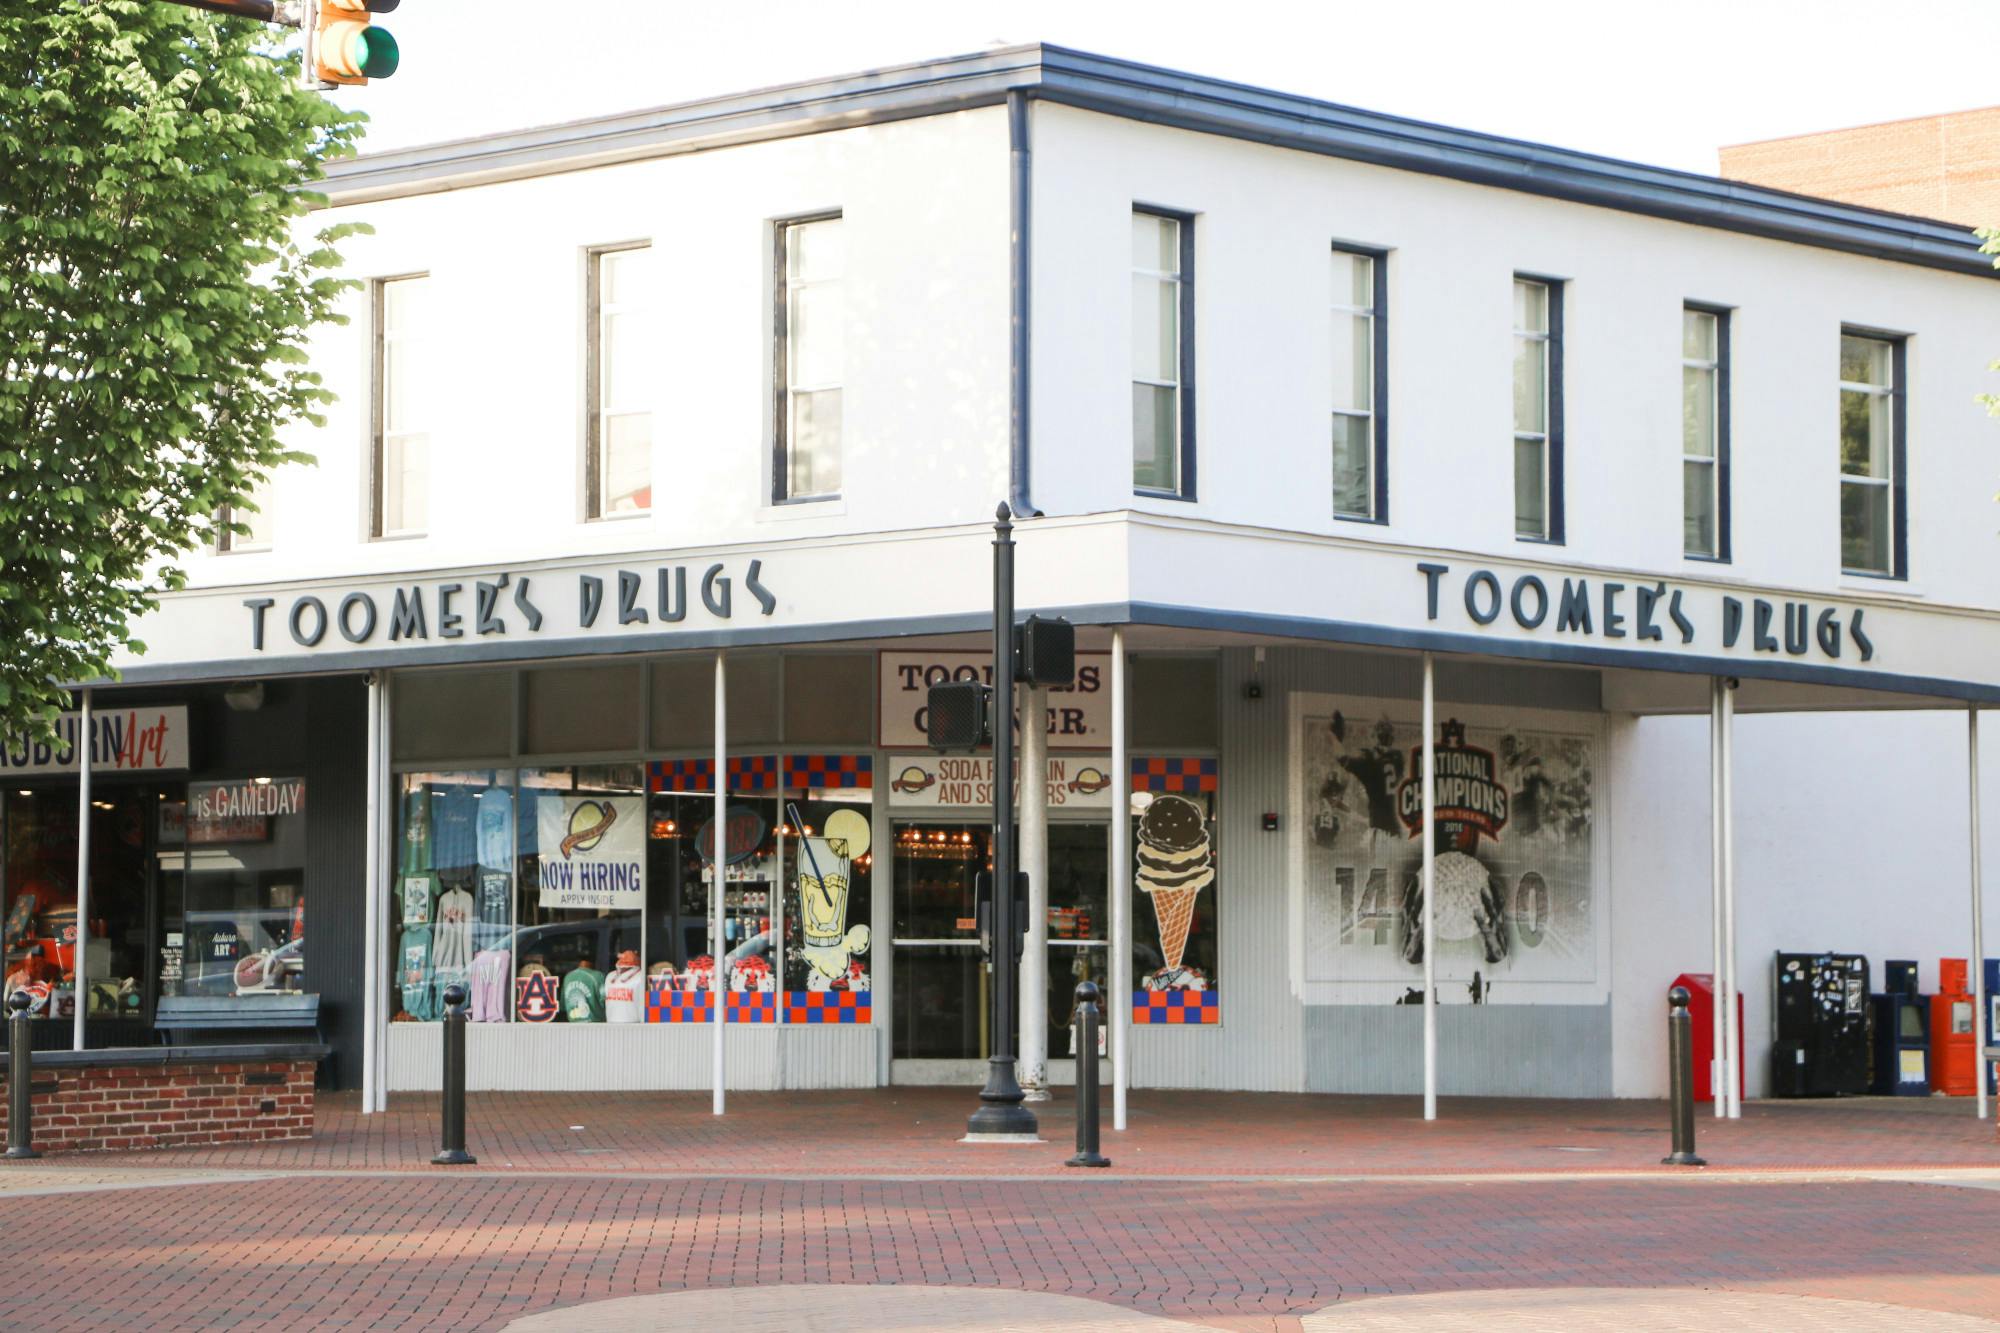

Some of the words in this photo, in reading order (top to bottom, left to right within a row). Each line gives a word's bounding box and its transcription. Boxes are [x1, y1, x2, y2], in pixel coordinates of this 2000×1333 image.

[243, 573, 542, 650] TOOMER'S
[580, 559, 776, 628] DRUGS
[1417, 563, 1694, 643] TOOMER'S
[1723, 595, 1873, 661] DRUGS
[117, 711, 169, 768] Art
[939, 759, 984, 781] SODA
[197, 794, 210, 818] is
[216, 783, 300, 817] GAMEDAY
[938, 783, 971, 804] AND
[540, 861, 574, 890] NOW
[580, 862, 641, 892] HIRING
[560, 894, 585, 905] APPLY
[588, 895, 615, 905] INSIDE
[1335, 867, 1392, 945] 14
[214, 944, 230, 956] ART
